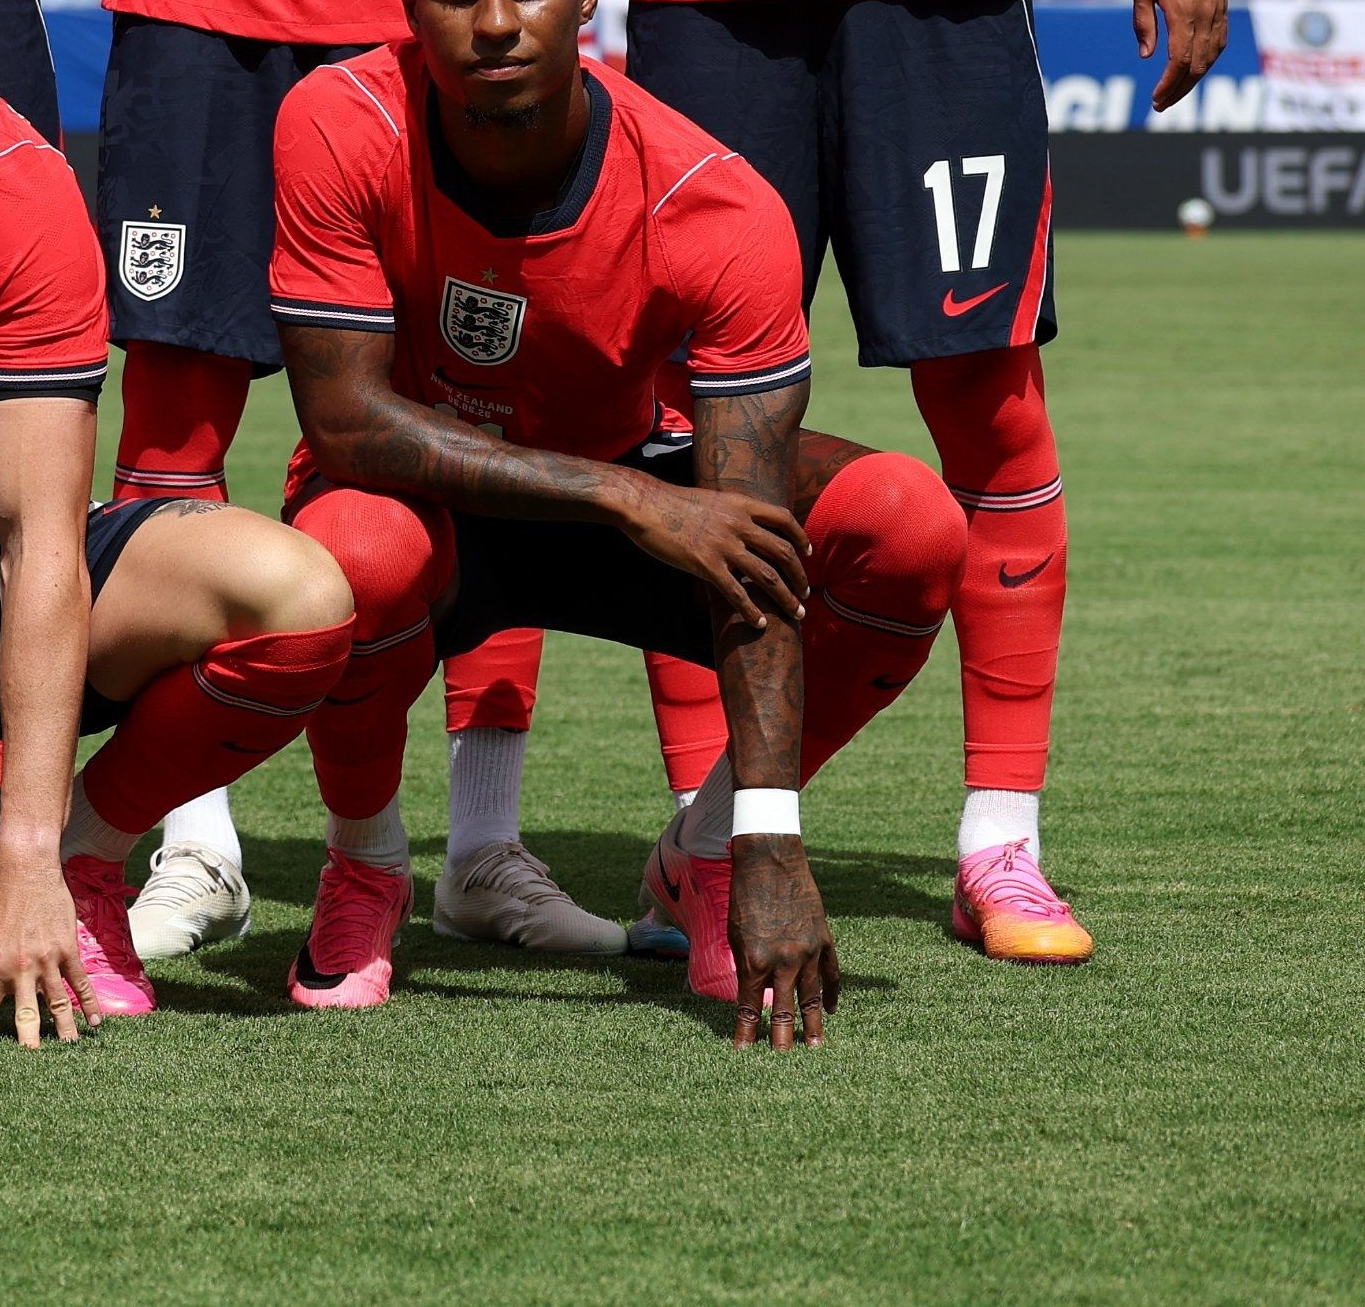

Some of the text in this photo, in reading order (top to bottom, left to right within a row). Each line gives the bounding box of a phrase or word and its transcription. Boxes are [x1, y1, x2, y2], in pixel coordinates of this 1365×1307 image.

[923, 154, 1006, 273] 17
[431, 372, 513, 415] NEW ZEALAND
